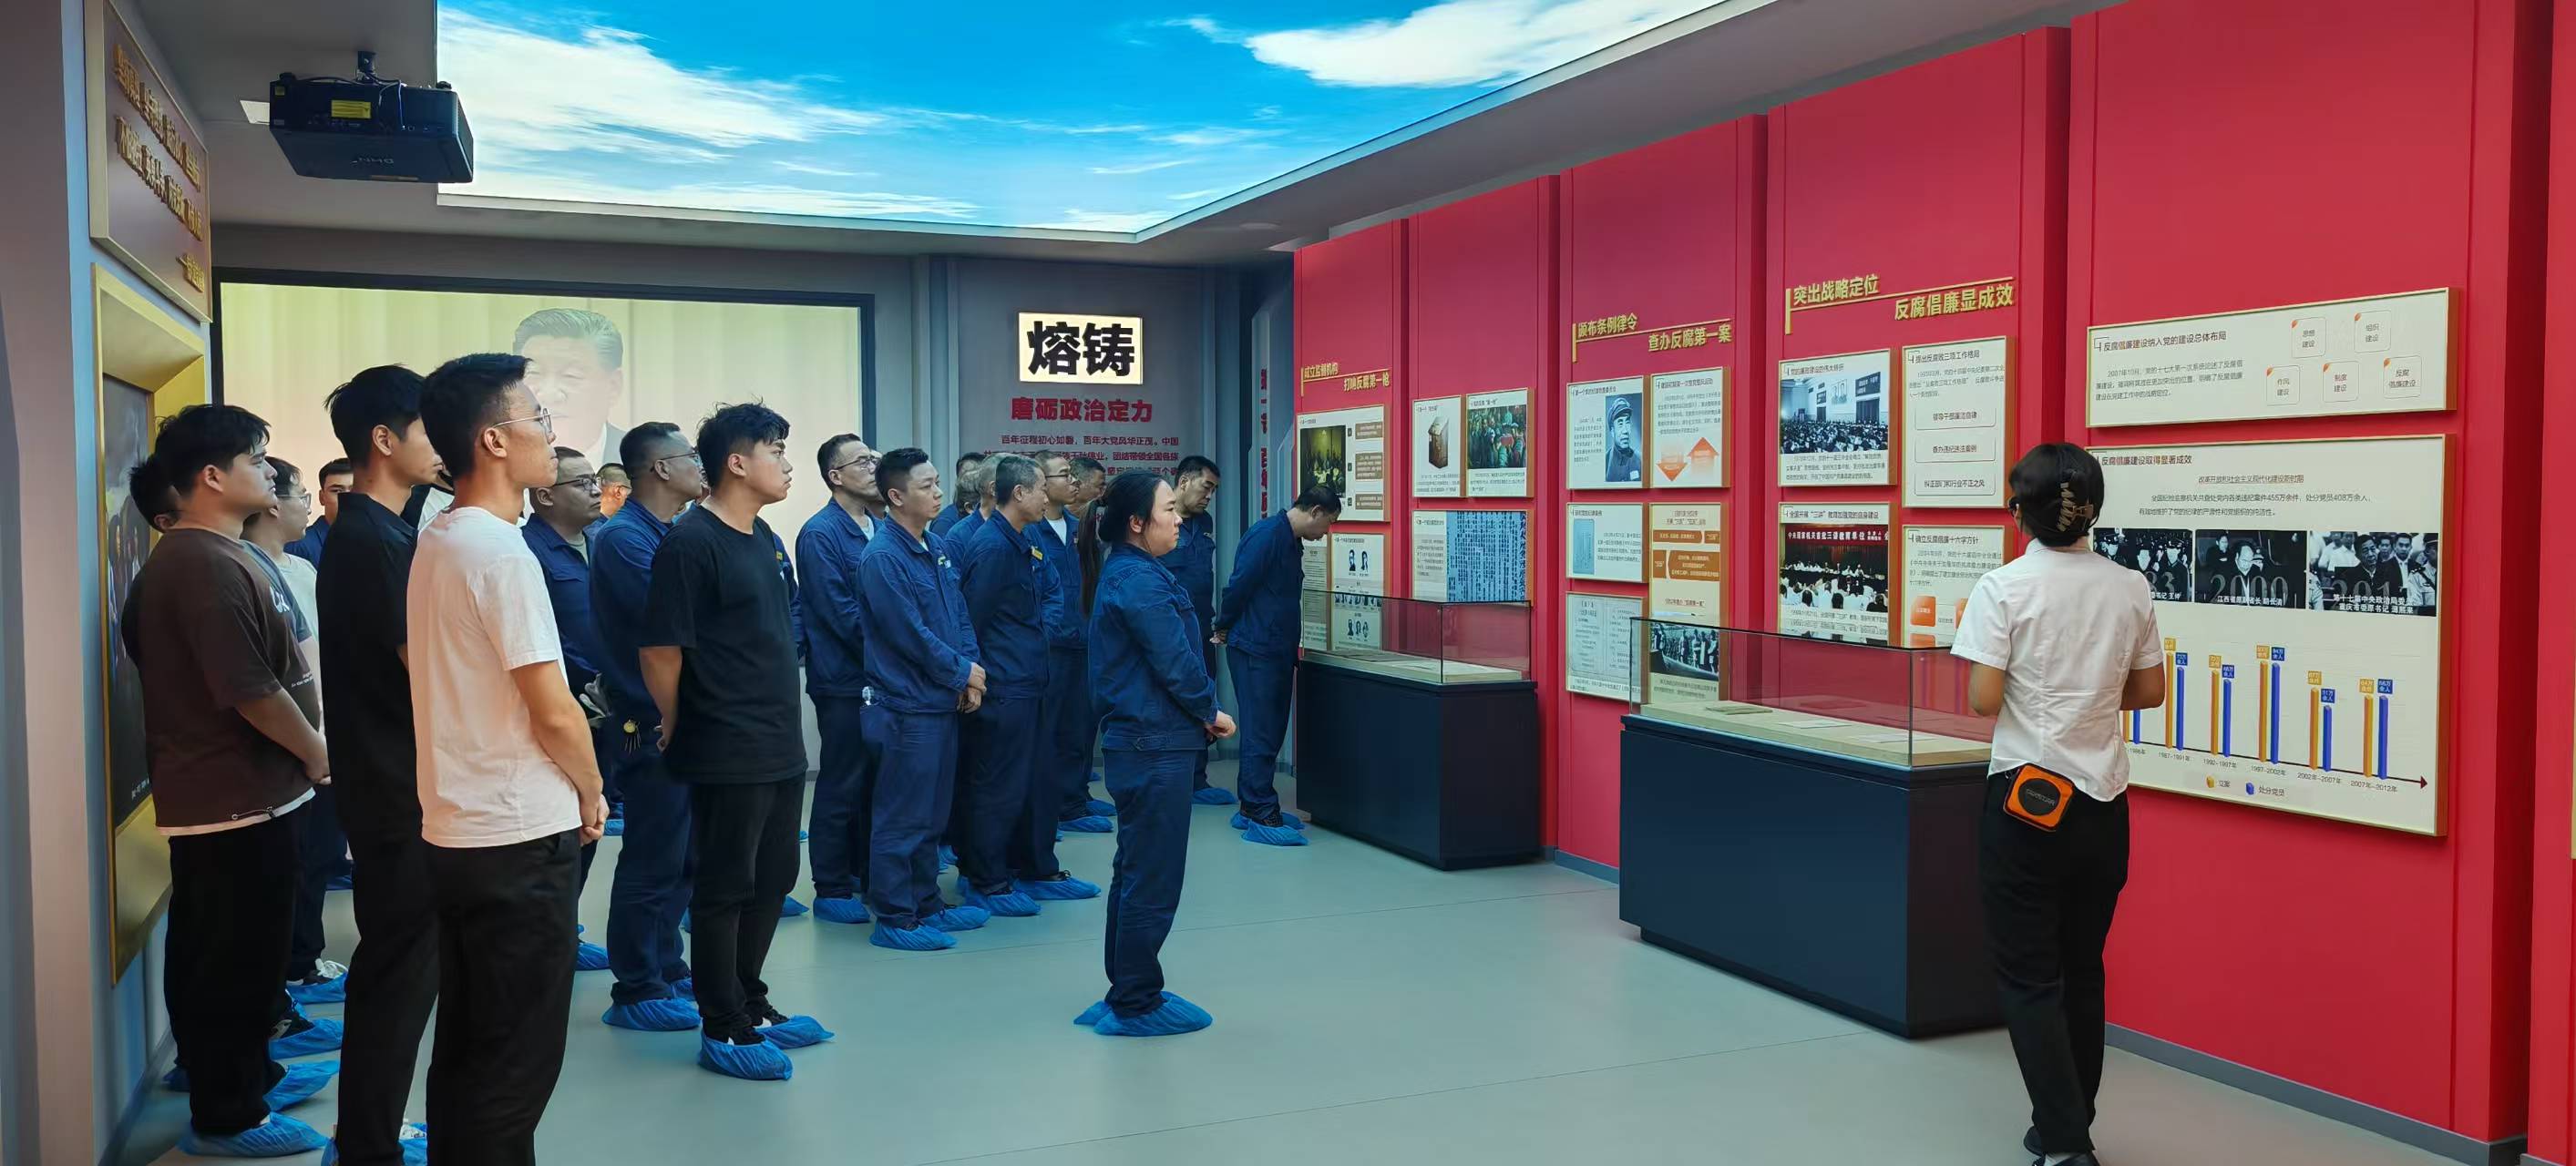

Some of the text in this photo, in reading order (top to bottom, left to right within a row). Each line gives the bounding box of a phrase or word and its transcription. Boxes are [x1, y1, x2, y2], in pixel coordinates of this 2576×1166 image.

[1792, 274, 1880, 305] 突出战略定位
[1894, 283, 2014, 321] 反腐倡廉显成效
[1577, 312, 1637, 338] 颁布条例律令
[2302, 329, 2315, 338] 思想
[1026, 321, 1135, 377] 熔铸
[1647, 323, 1732, 352] 查办反腐第一案
[2103, 330, 2227, 352] 反腐倡廉建设纳入党的建设总体布局
[2302, 340, 2315, 348] 建设
[2366, 333, 2379, 343] 建设
[2334, 384, 2347, 393] 建设
[1011, 396, 1153, 423] 磨砺政治定力
[2101, 455, 2192, 465] 反腐倡廉建设取得显著成效
